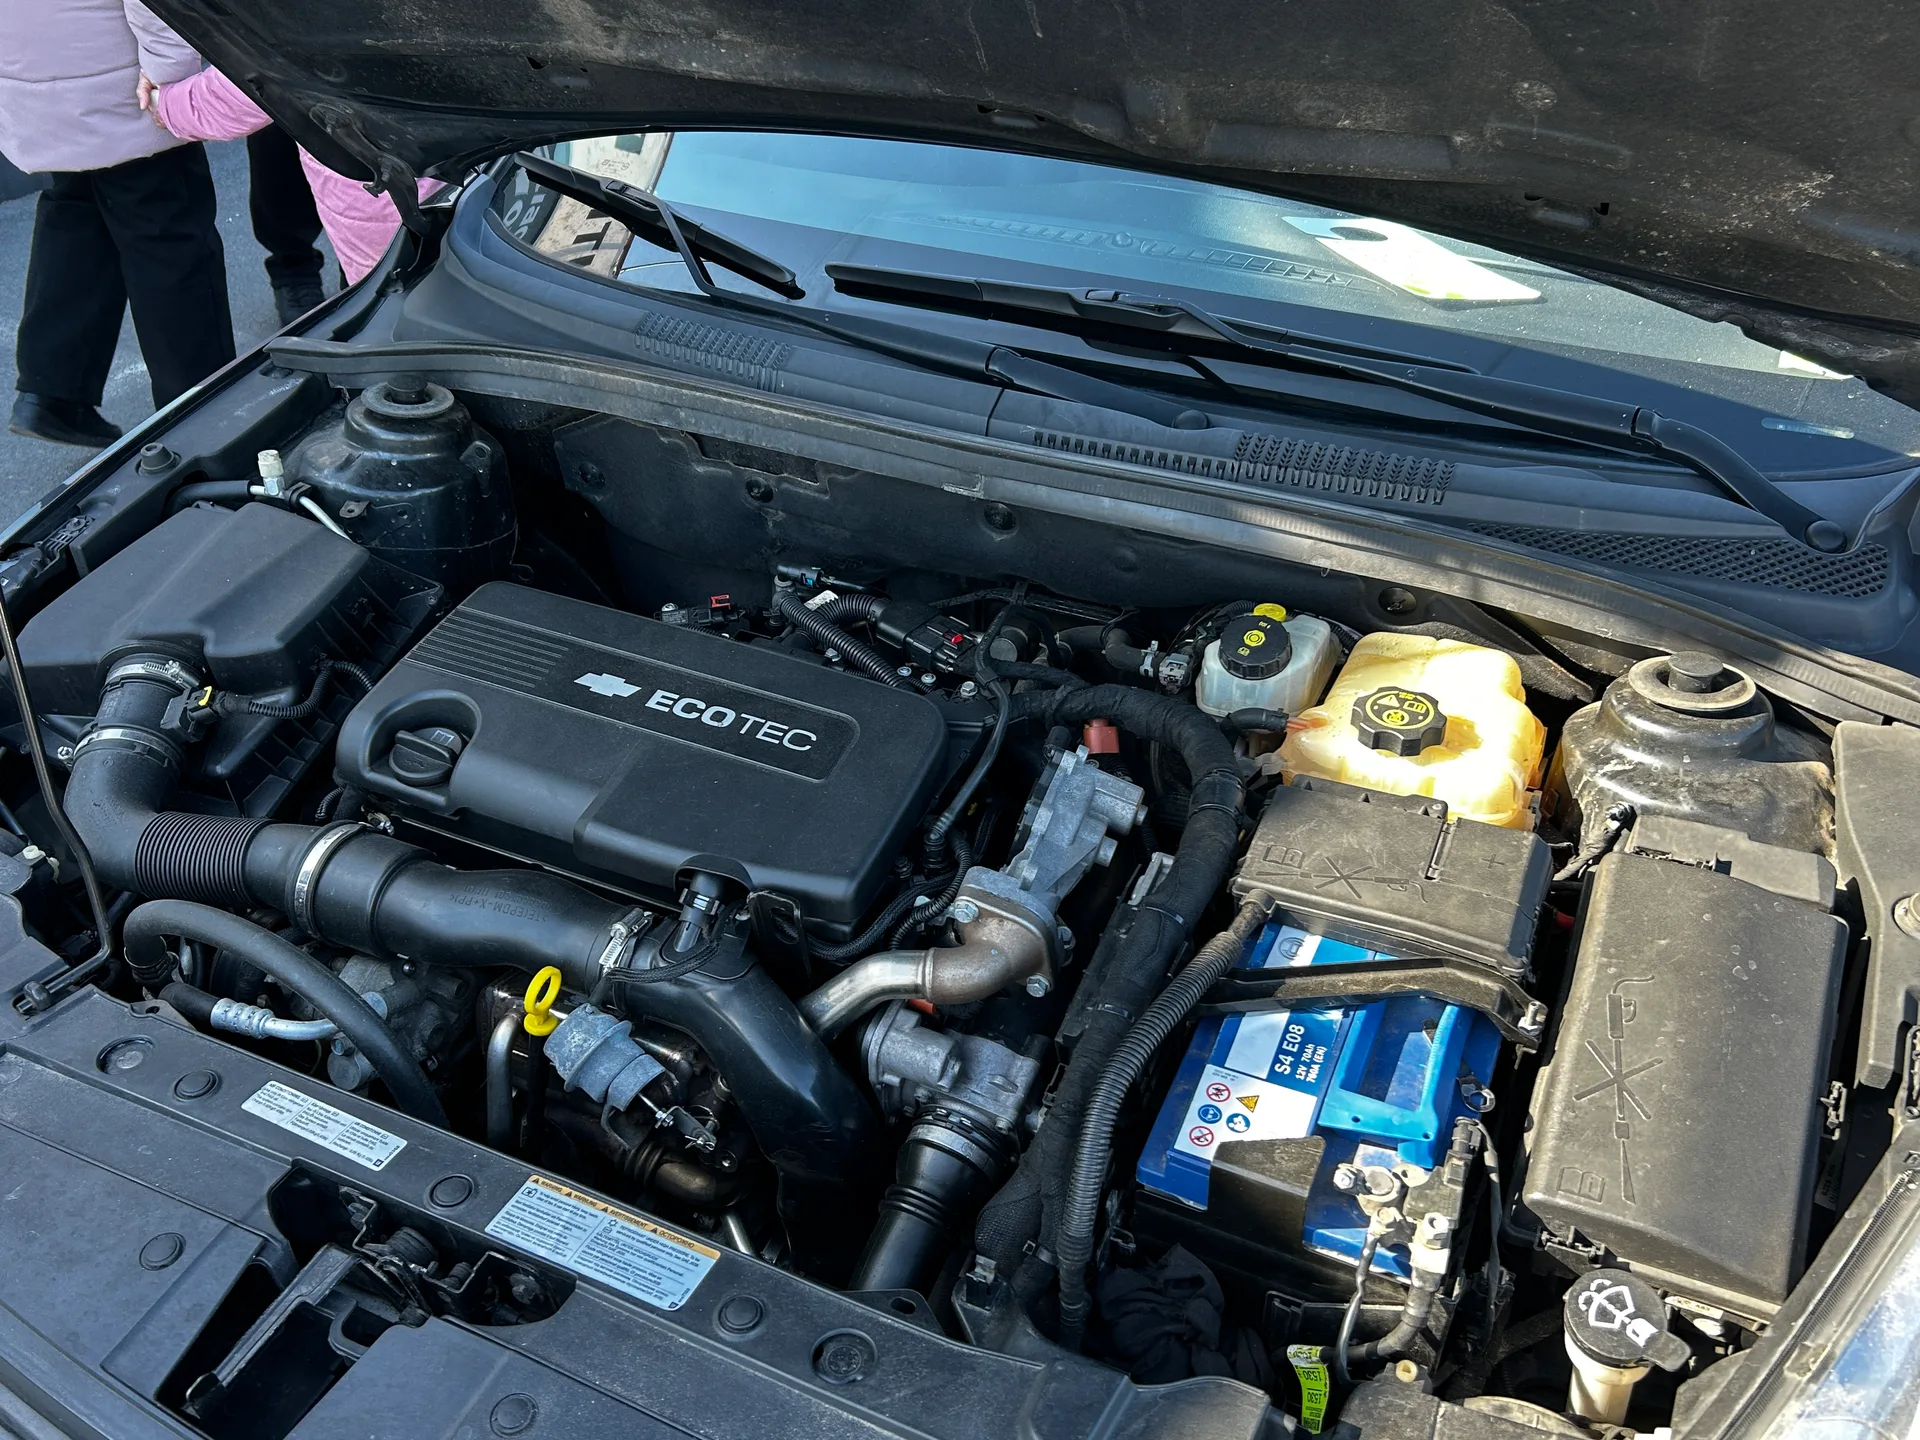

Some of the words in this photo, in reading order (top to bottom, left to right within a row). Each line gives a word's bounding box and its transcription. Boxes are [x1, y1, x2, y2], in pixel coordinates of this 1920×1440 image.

[645, 689, 817, 751] ECOTEC
[1282, 1024, 1305, 1052] E08
[1295, 1064, 1307, 1080] 12V
[1301, 1044, 1315, 1062] 70Ah
[1314, 1045, 1328, 1063] (EN)
[1274, 1054, 1295, 1075] S4
[539, 1179, 563, 1192] WARNING
[608, 1208, 648, 1228] AVERTISSEMENT
[1302, 1370, 1322, 1381] 1530
[1307, 1392, 1321, 1404] 1530
